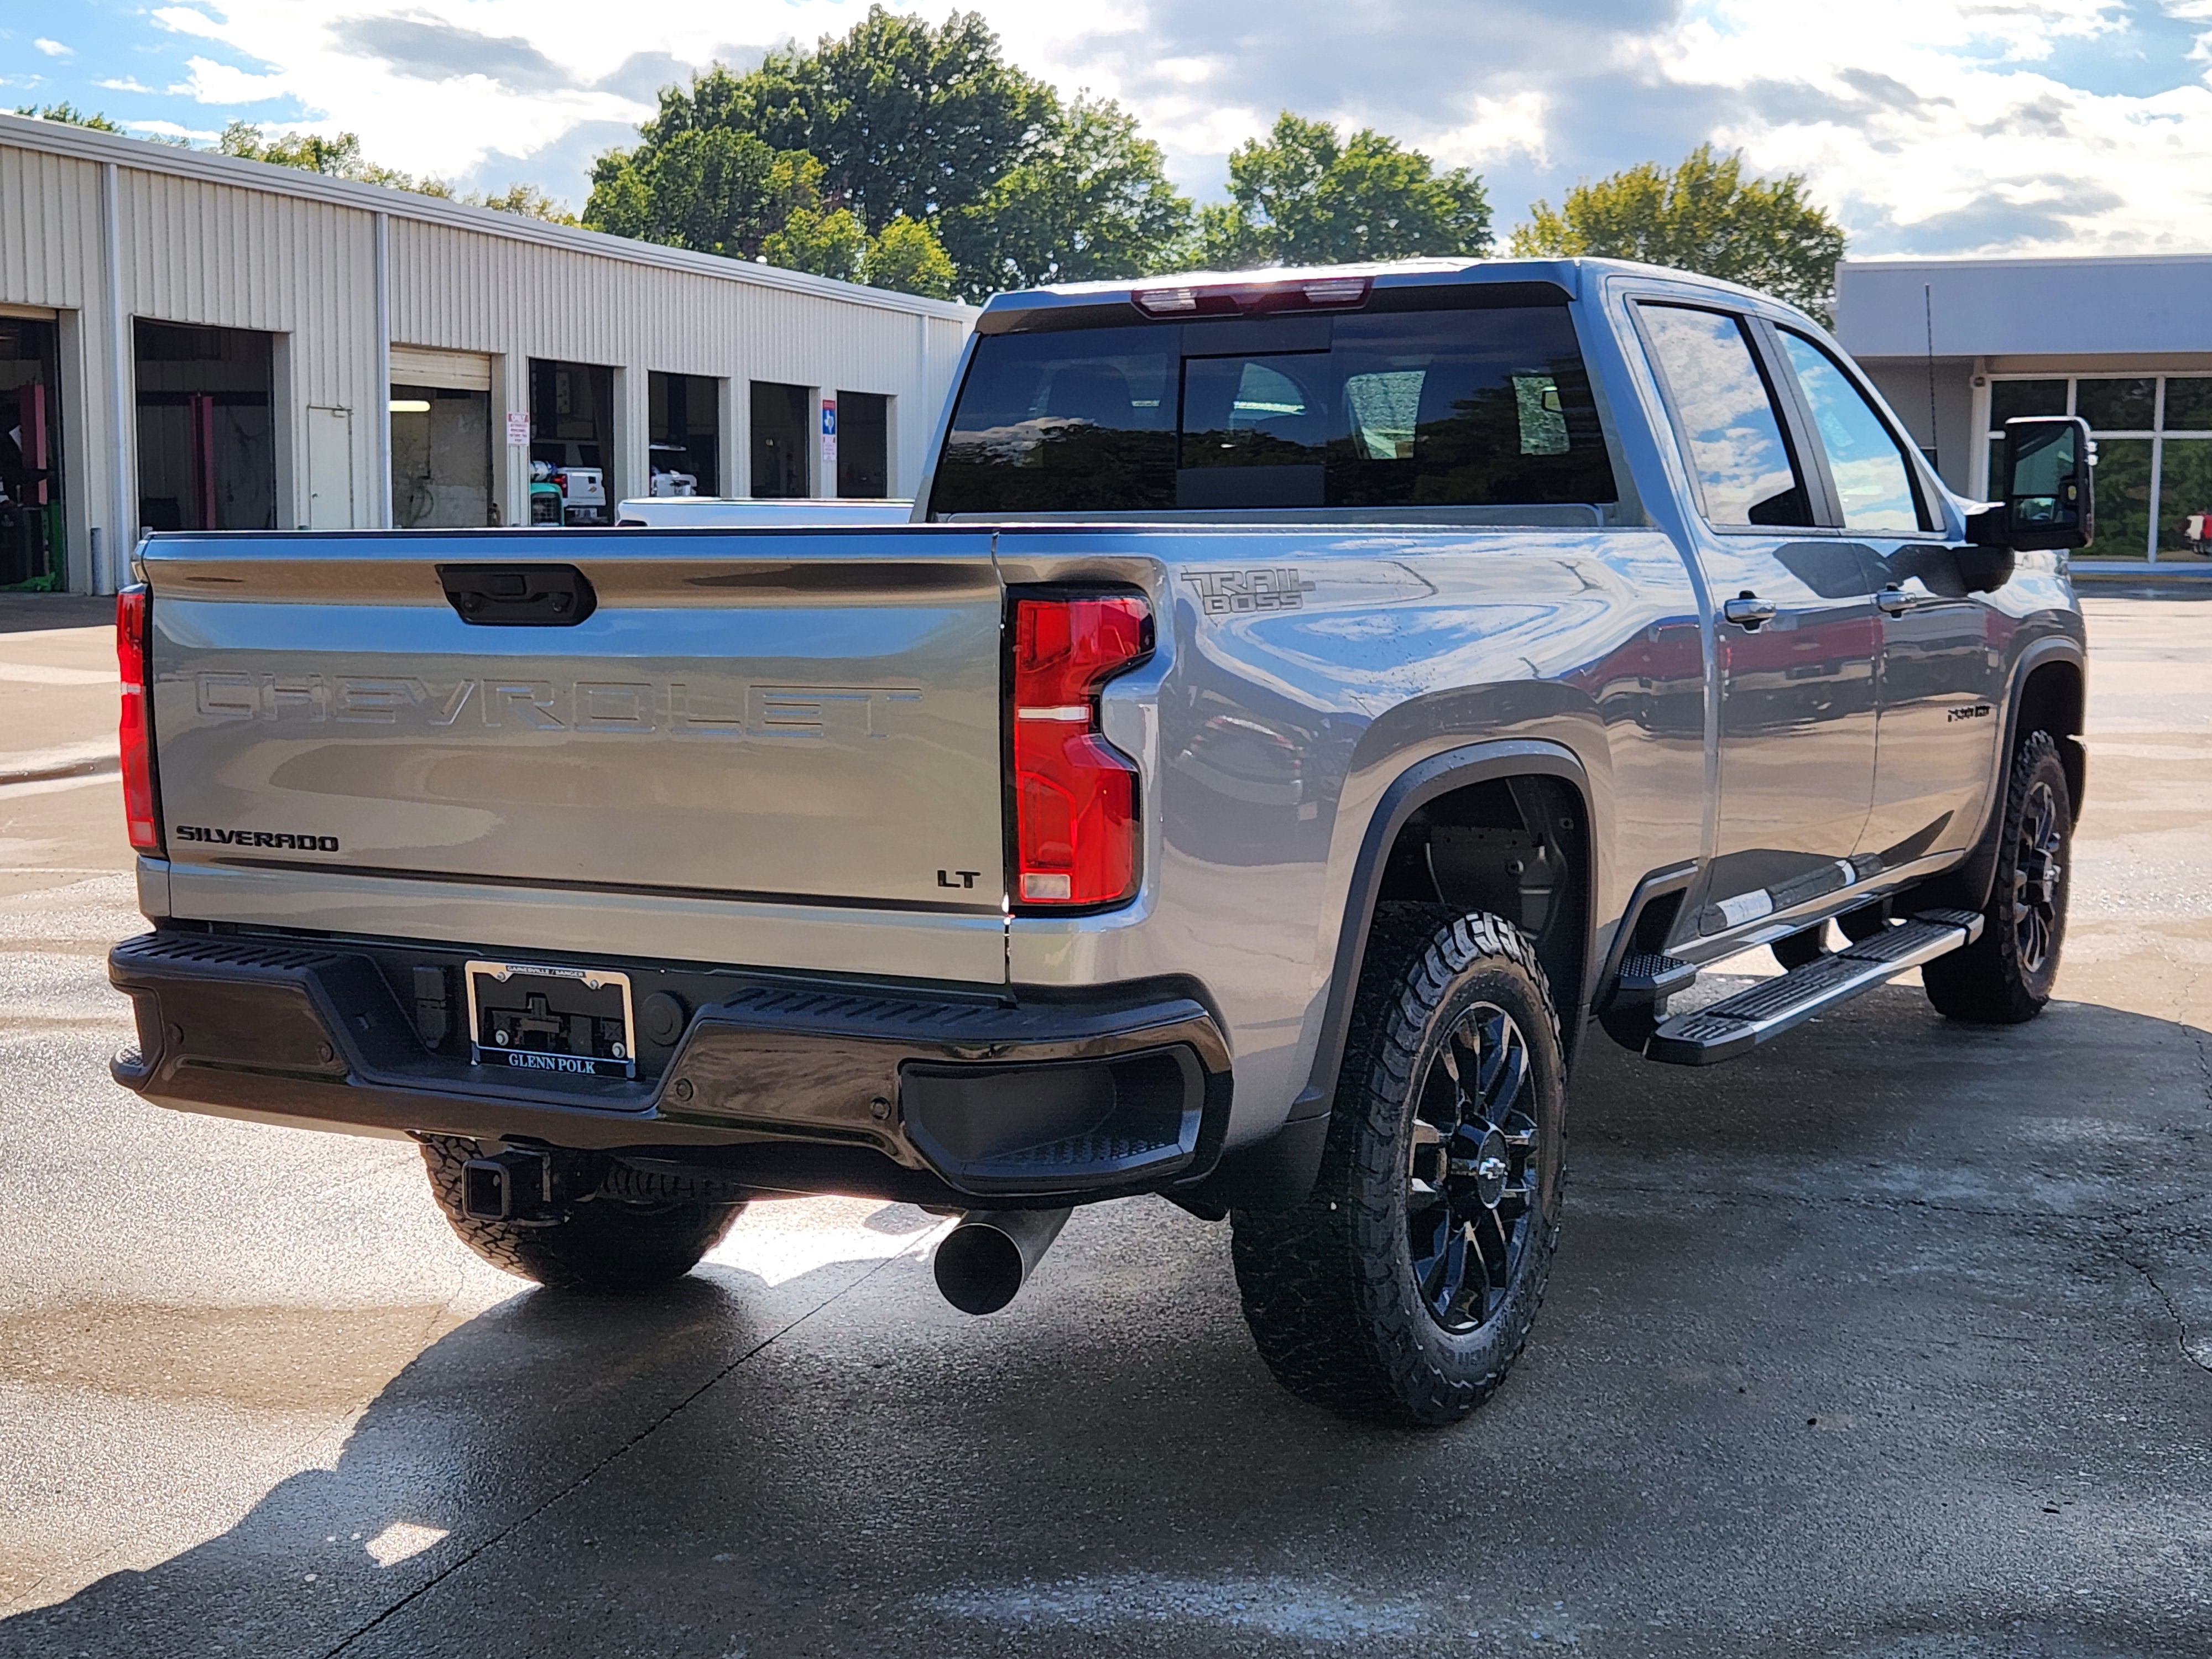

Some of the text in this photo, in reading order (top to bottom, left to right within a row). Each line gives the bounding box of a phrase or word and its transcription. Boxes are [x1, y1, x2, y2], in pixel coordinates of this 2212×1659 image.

[1181, 568, 1316, 596] TRAIL
[1203, 592, 1303, 615] BOSS
[195, 670, 923, 738] CHEVROLET
[176, 825, 339, 852] SILVERADO
[937, 870, 982, 889] LT
[508, 1053, 596, 1074] GLENN POLK
